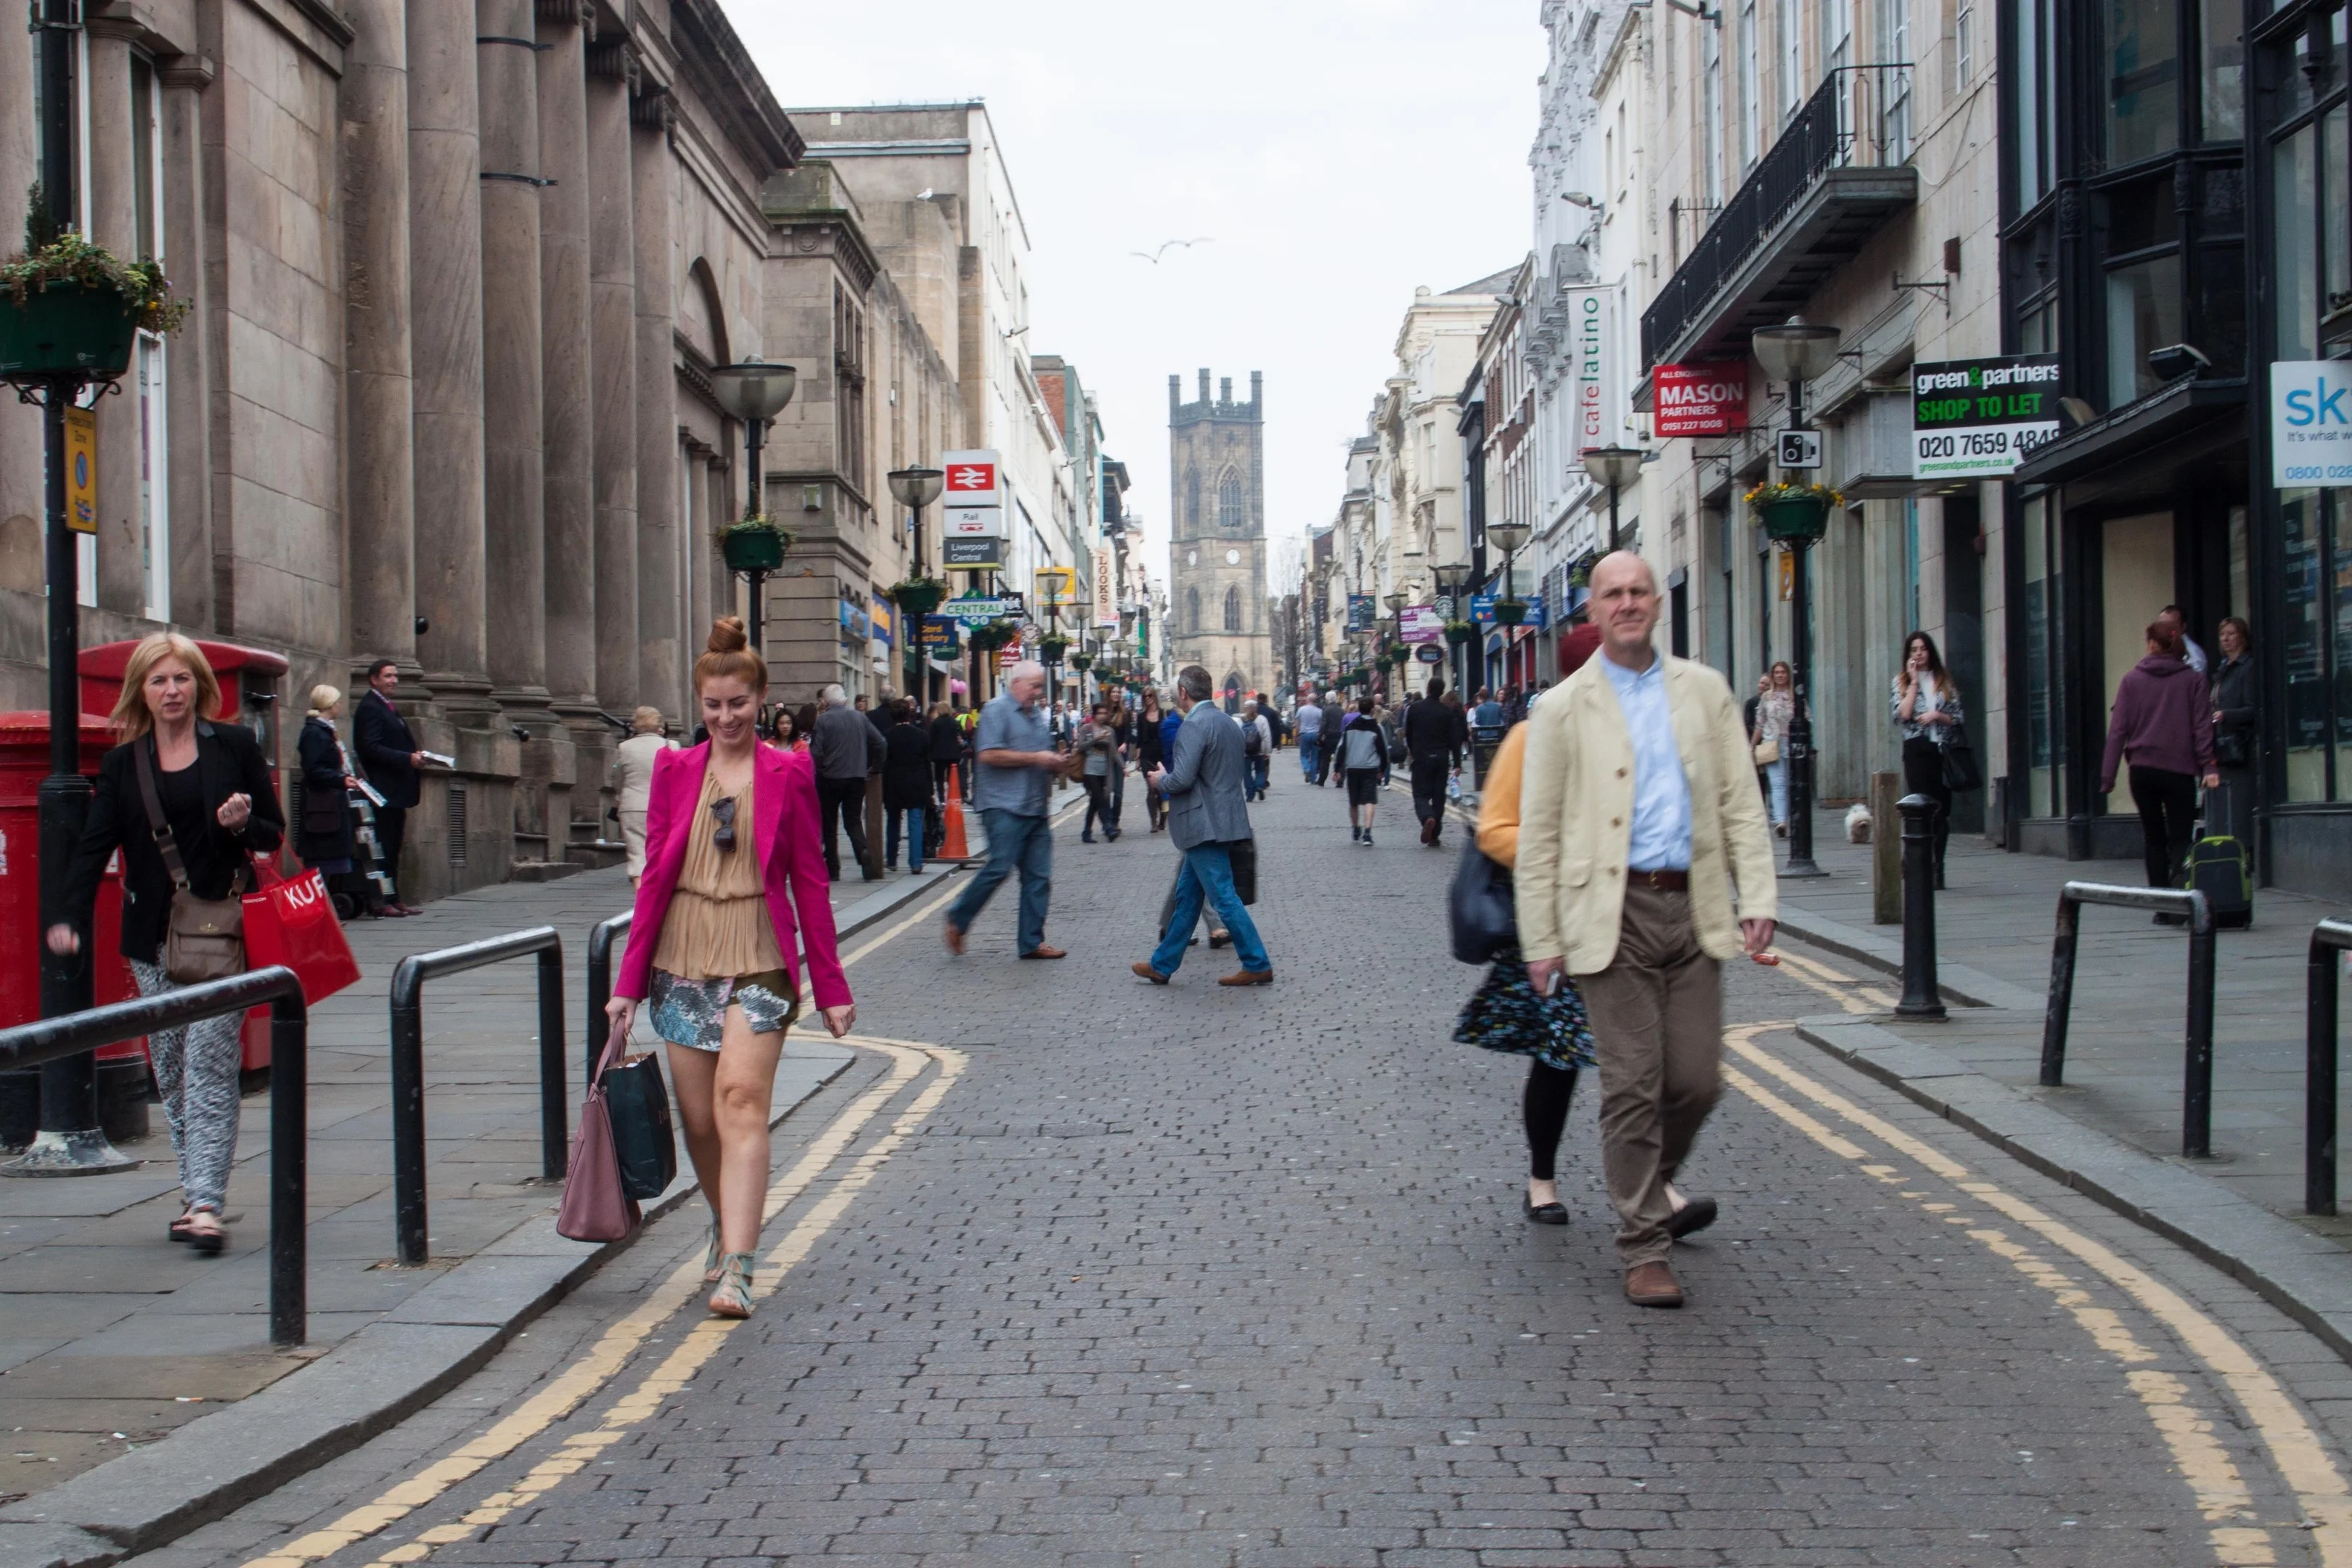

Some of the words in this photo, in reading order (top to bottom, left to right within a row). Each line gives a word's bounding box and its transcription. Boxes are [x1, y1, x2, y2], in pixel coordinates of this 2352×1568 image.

[1917, 364, 2059, 394] green&partners
[1660, 383, 1744, 406] MASON
[2285, 376, 2352, 426] sk
[1660, 404, 1717, 417] PARTNERS
[1917, 398, 1971, 422] SHOP
[1977, 396, 2002, 418] TO
[2008, 393, 2043, 416] LET
[1661, 422, 1681, 431] 0151
[1682, 420, 1699, 430] 227
[2308, 430, 2339, 441] what
[1919, 436, 1955, 459] 020
[1960, 431, 2008, 456] 7659
[2284, 466, 2323, 479] 0800
[950, 542, 990, 552] Liverpool
[950, 553, 982, 562] Central
[1098, 556, 1108, 603] LOOKS
[946, 604, 1003, 614] CENTRAL
